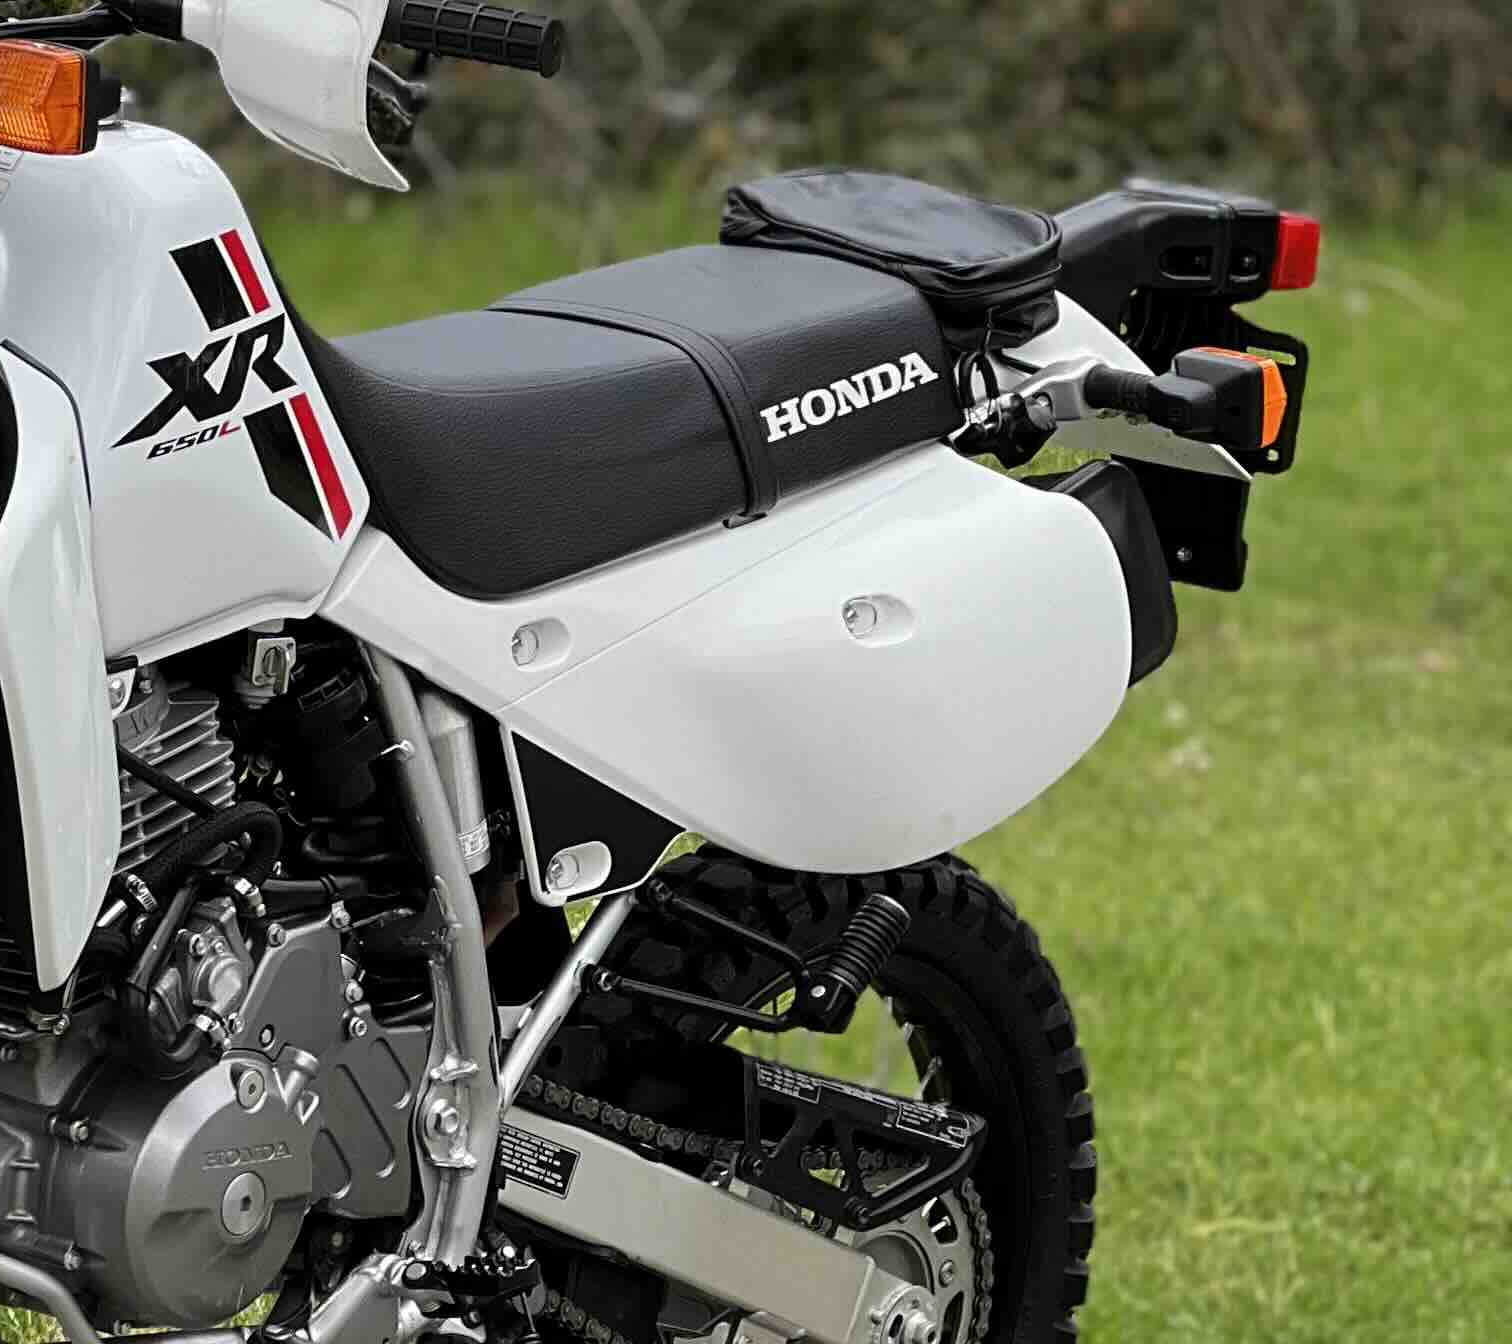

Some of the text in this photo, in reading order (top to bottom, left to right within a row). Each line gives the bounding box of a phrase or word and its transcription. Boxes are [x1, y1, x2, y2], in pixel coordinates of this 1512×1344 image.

[111, 313, 297, 448] XR
[759, 352, 939, 443] HONDA
[146, 420, 241, 459] 650L
[201, 1142, 293, 1171] HONDA
